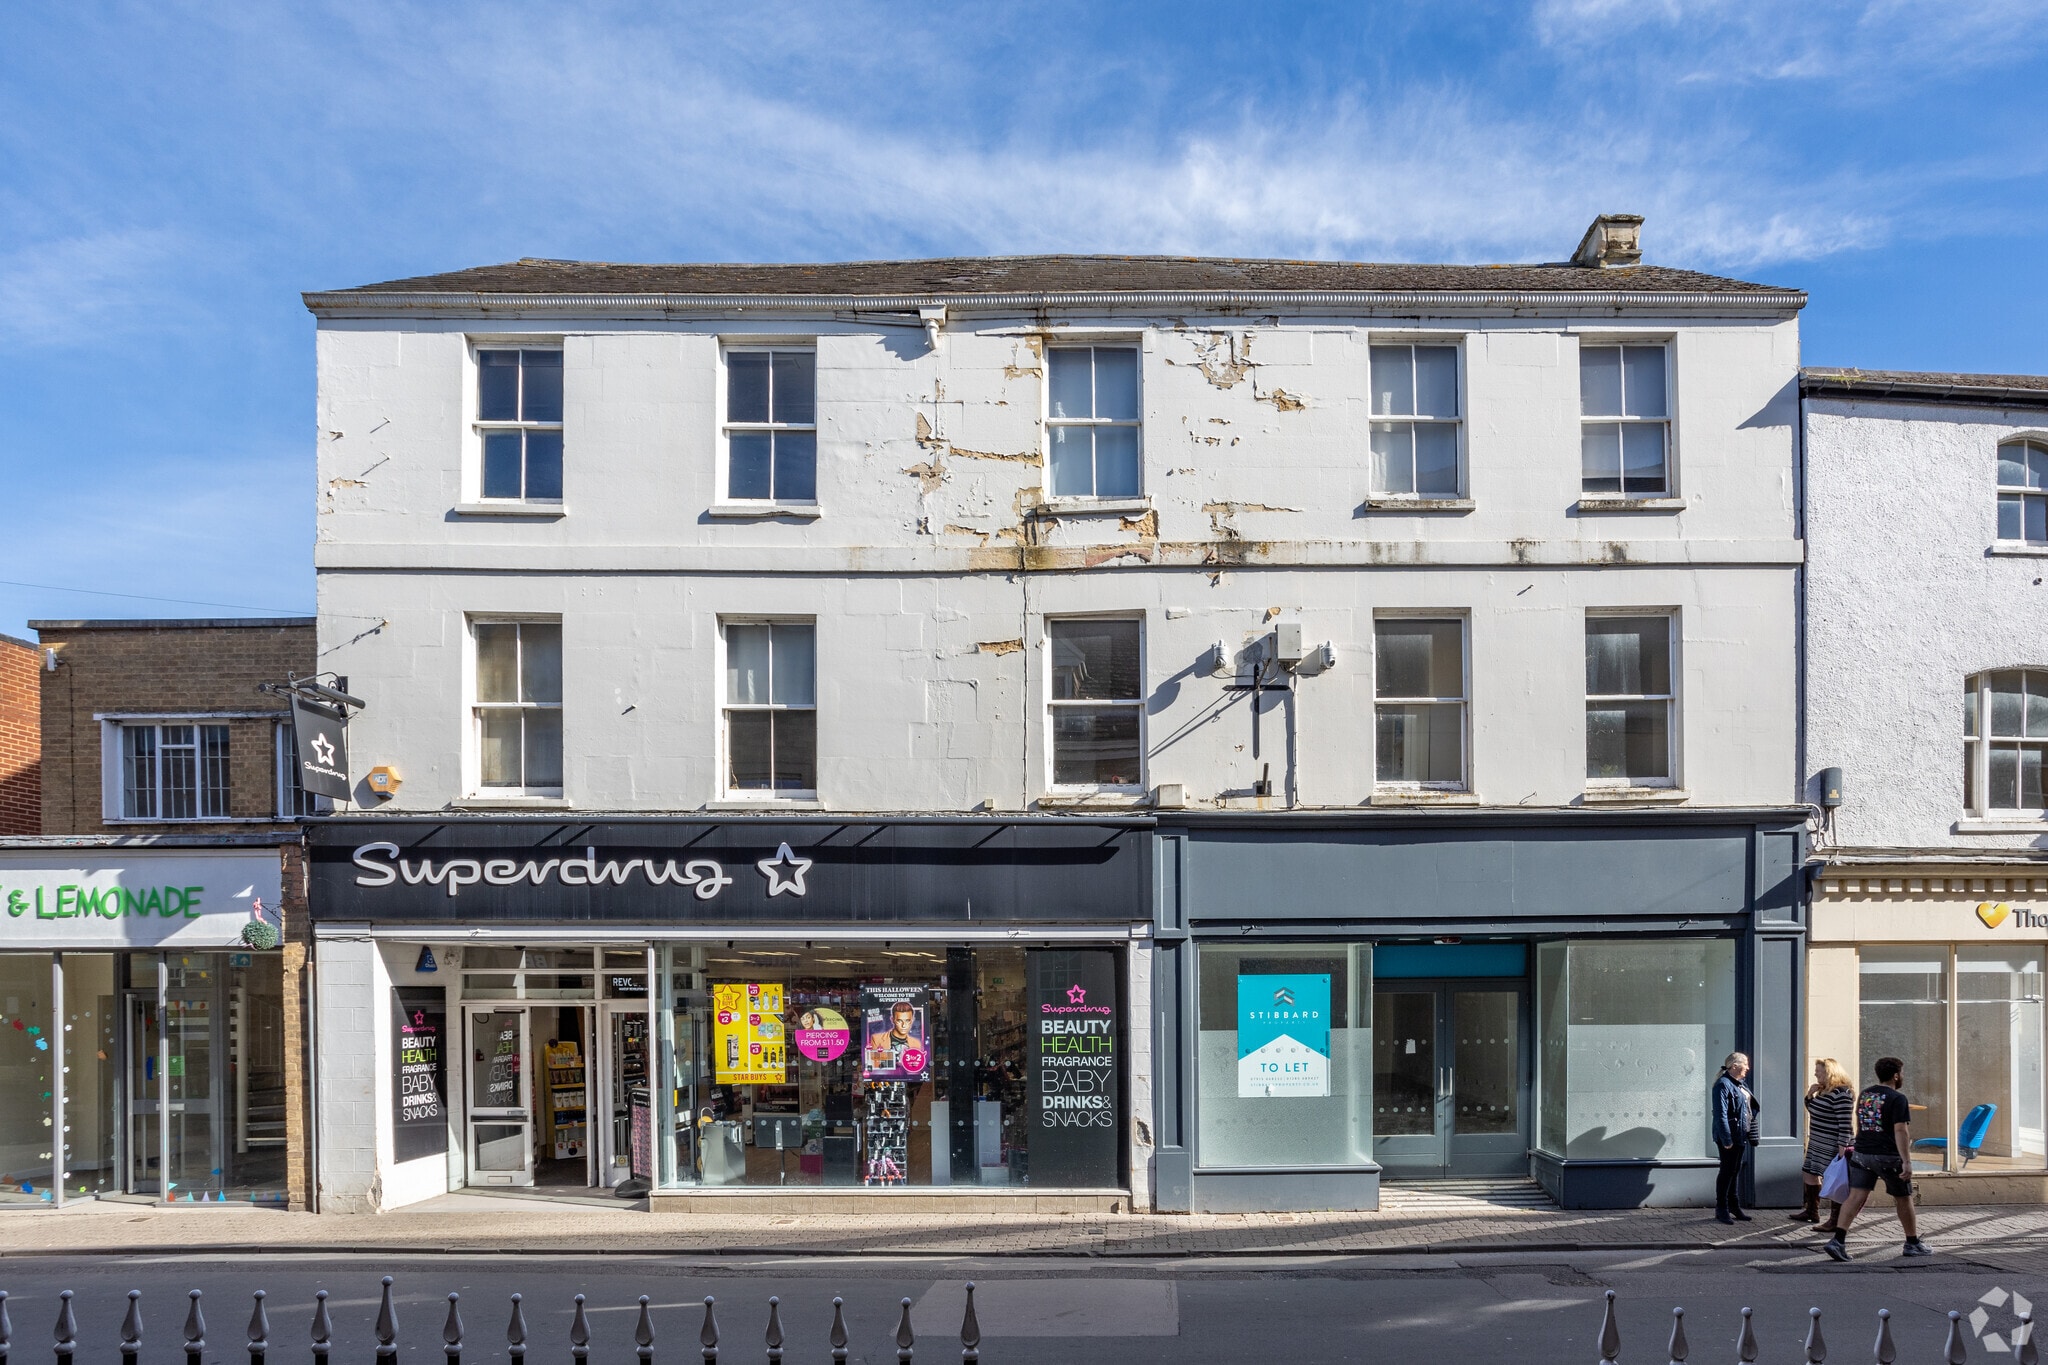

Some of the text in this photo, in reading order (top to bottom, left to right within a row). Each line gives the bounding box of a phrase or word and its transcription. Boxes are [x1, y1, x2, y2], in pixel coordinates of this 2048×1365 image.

[304, 761, 348, 781] Superdrug
[353, 841, 733, 900] Superdrug
[8, 884, 205, 920] & LEMONADE
[1041, 1004, 1112, 1015] Superdrug
[1249, 1011, 1319, 1019] STIBBARD
[1041, 1020, 1112, 1034] BEAUTY
[402, 1036, 436, 1049] BEAUTY
[1041, 1036, 1112, 1053] HEALTH
[402, 1048, 437, 1063] HEALTH
[1041, 1056, 1112, 1067] FRAGRANCE
[402, 1063, 437, 1075] FRAGRANCE
[1261, 1063, 1309, 1073] TO LET
[402, 1073, 437, 1095] BABY
[733, 1073, 767, 1081] STAR BUYS
[1042, 1070, 1112, 1093] BABY
[403, 1104, 438, 1121] SNACKS
[1042, 1110, 1113, 1128] SNACKS
